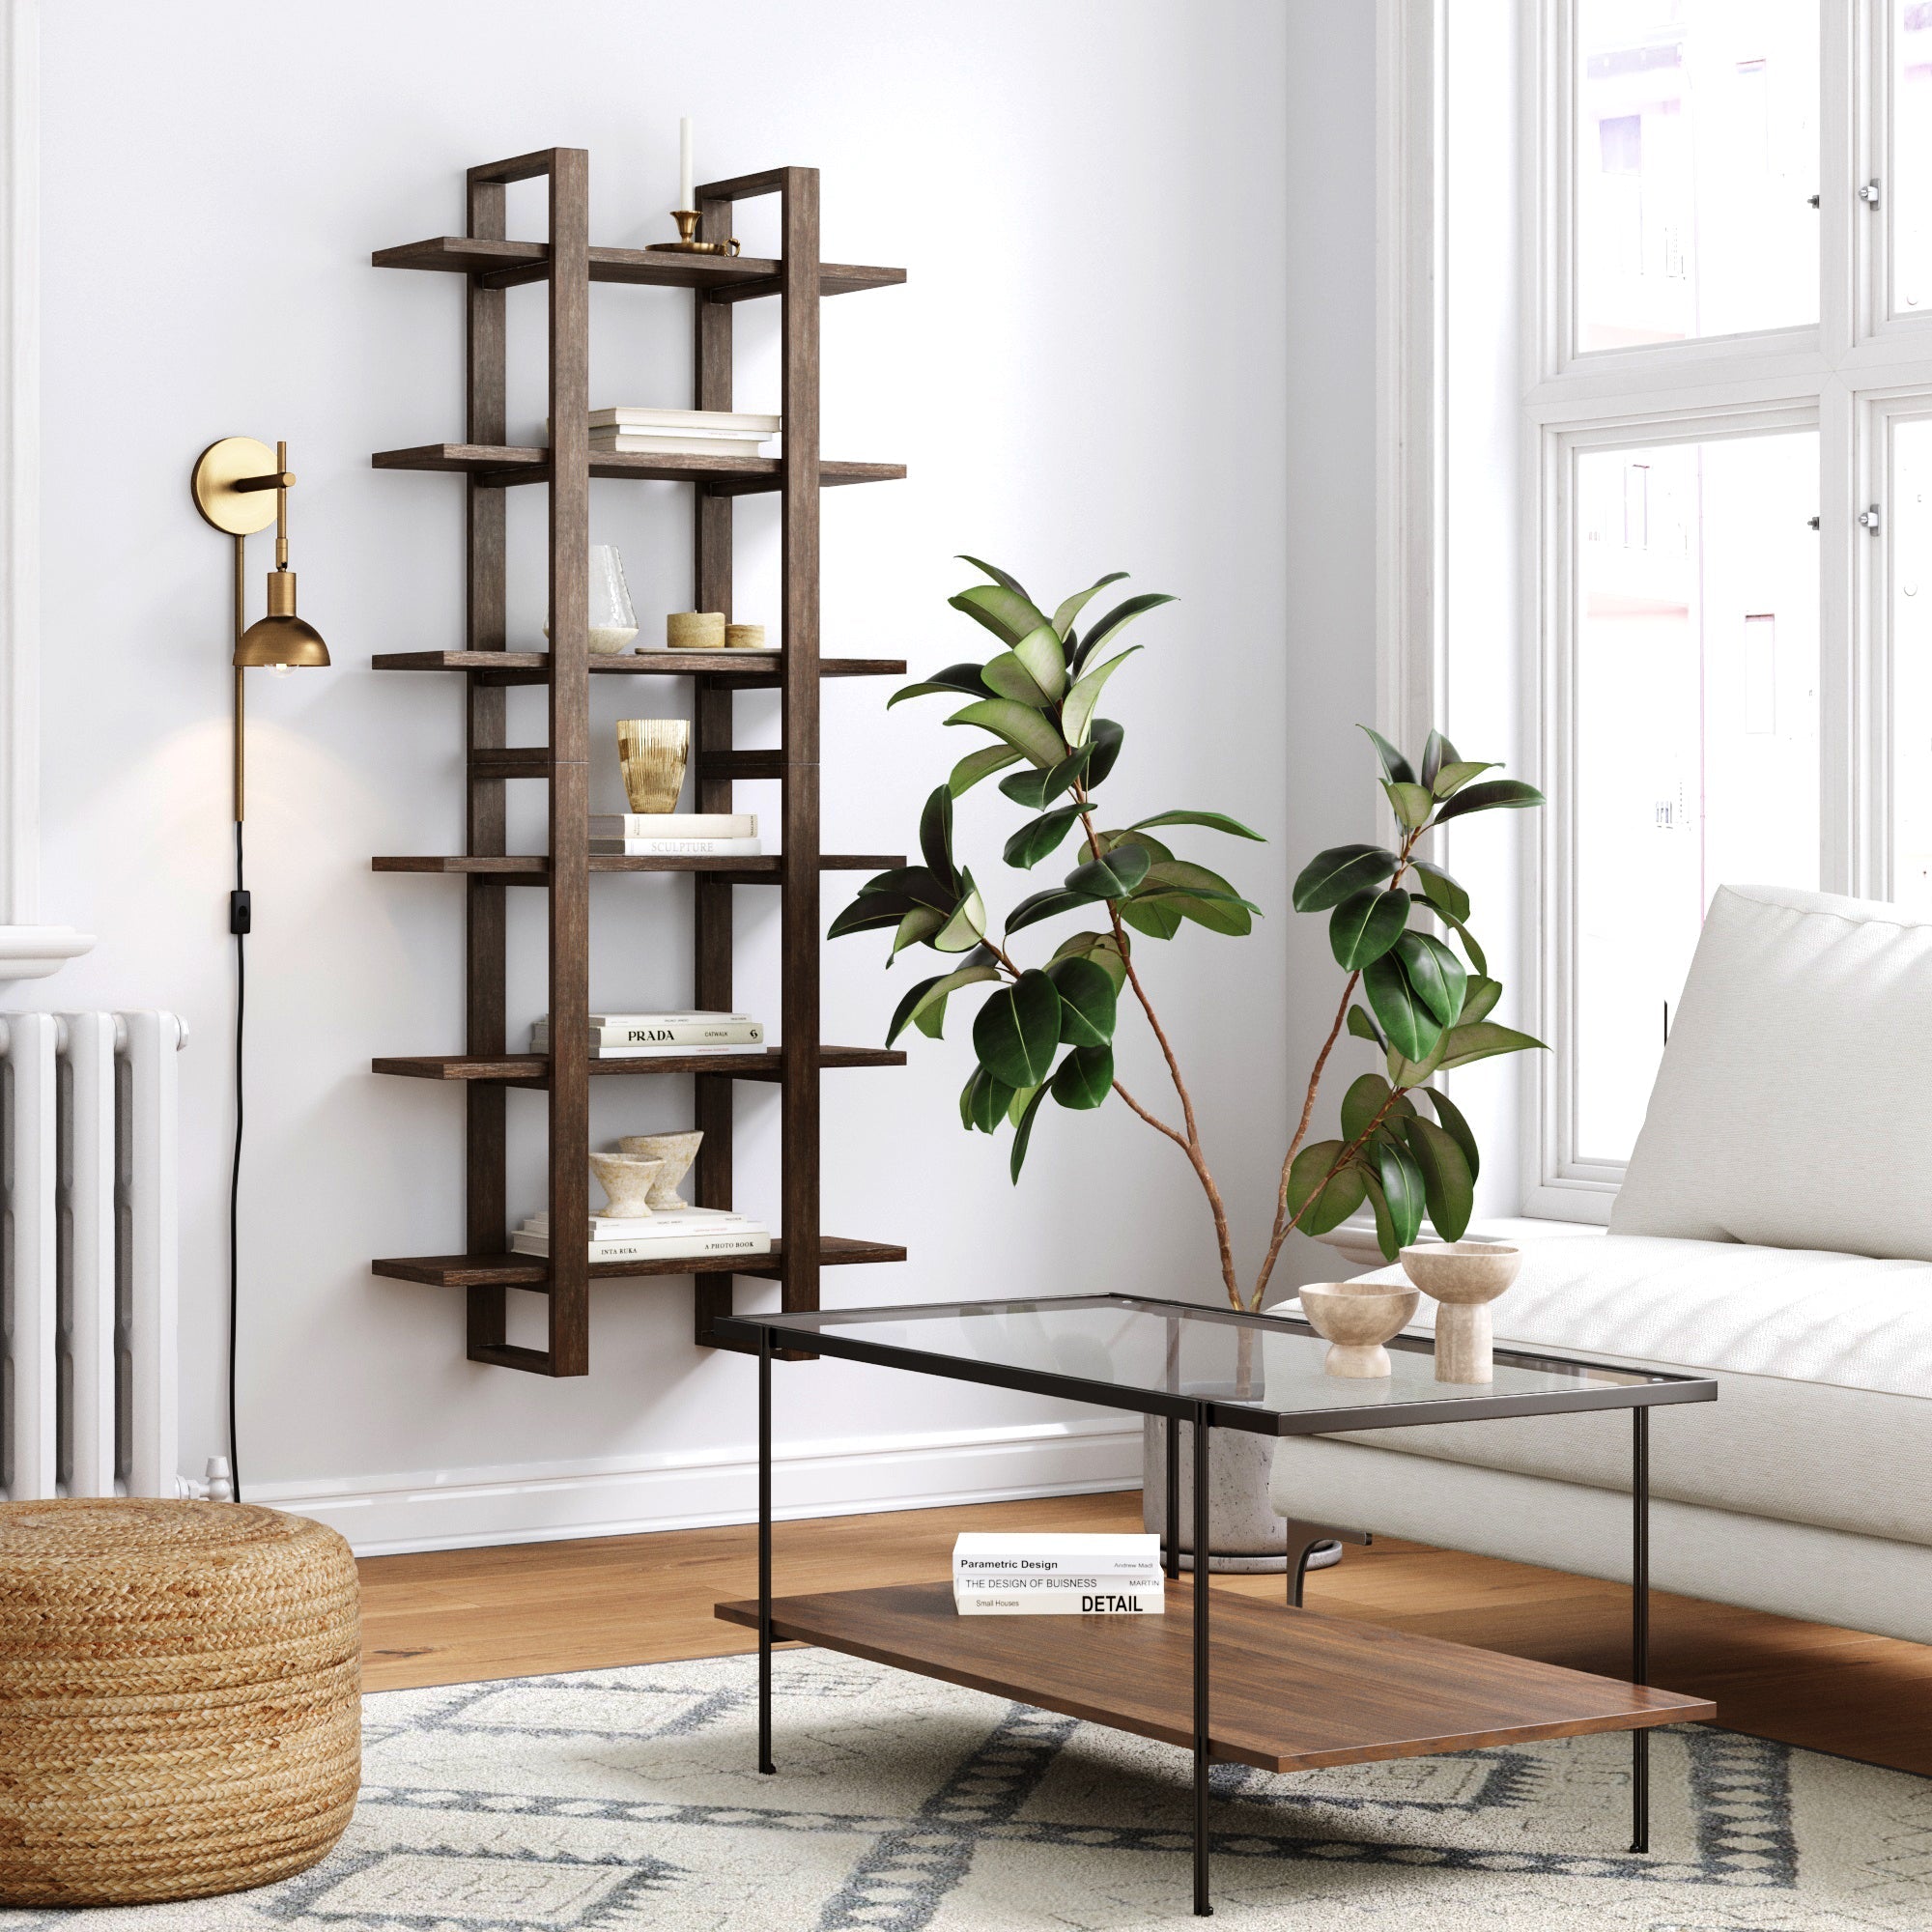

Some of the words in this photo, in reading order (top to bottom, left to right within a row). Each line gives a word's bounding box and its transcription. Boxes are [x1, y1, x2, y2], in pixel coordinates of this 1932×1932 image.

[651, 842, 714, 852] SCULPTURE
[628, 1030, 675, 1041] PRADA
[960, 1559, 1018, 1569] Parametric
[1021, 1560, 1058, 1571] Design
[966, 1579, 985, 1588] THE
[988, 1579, 1027, 1588] DESIGN
[1029, 1579, 1043, 1588] OF
[1046, 1579, 1097, 1588] BUISNESS
[1082, 1596, 1143, 1611] DETAIL
